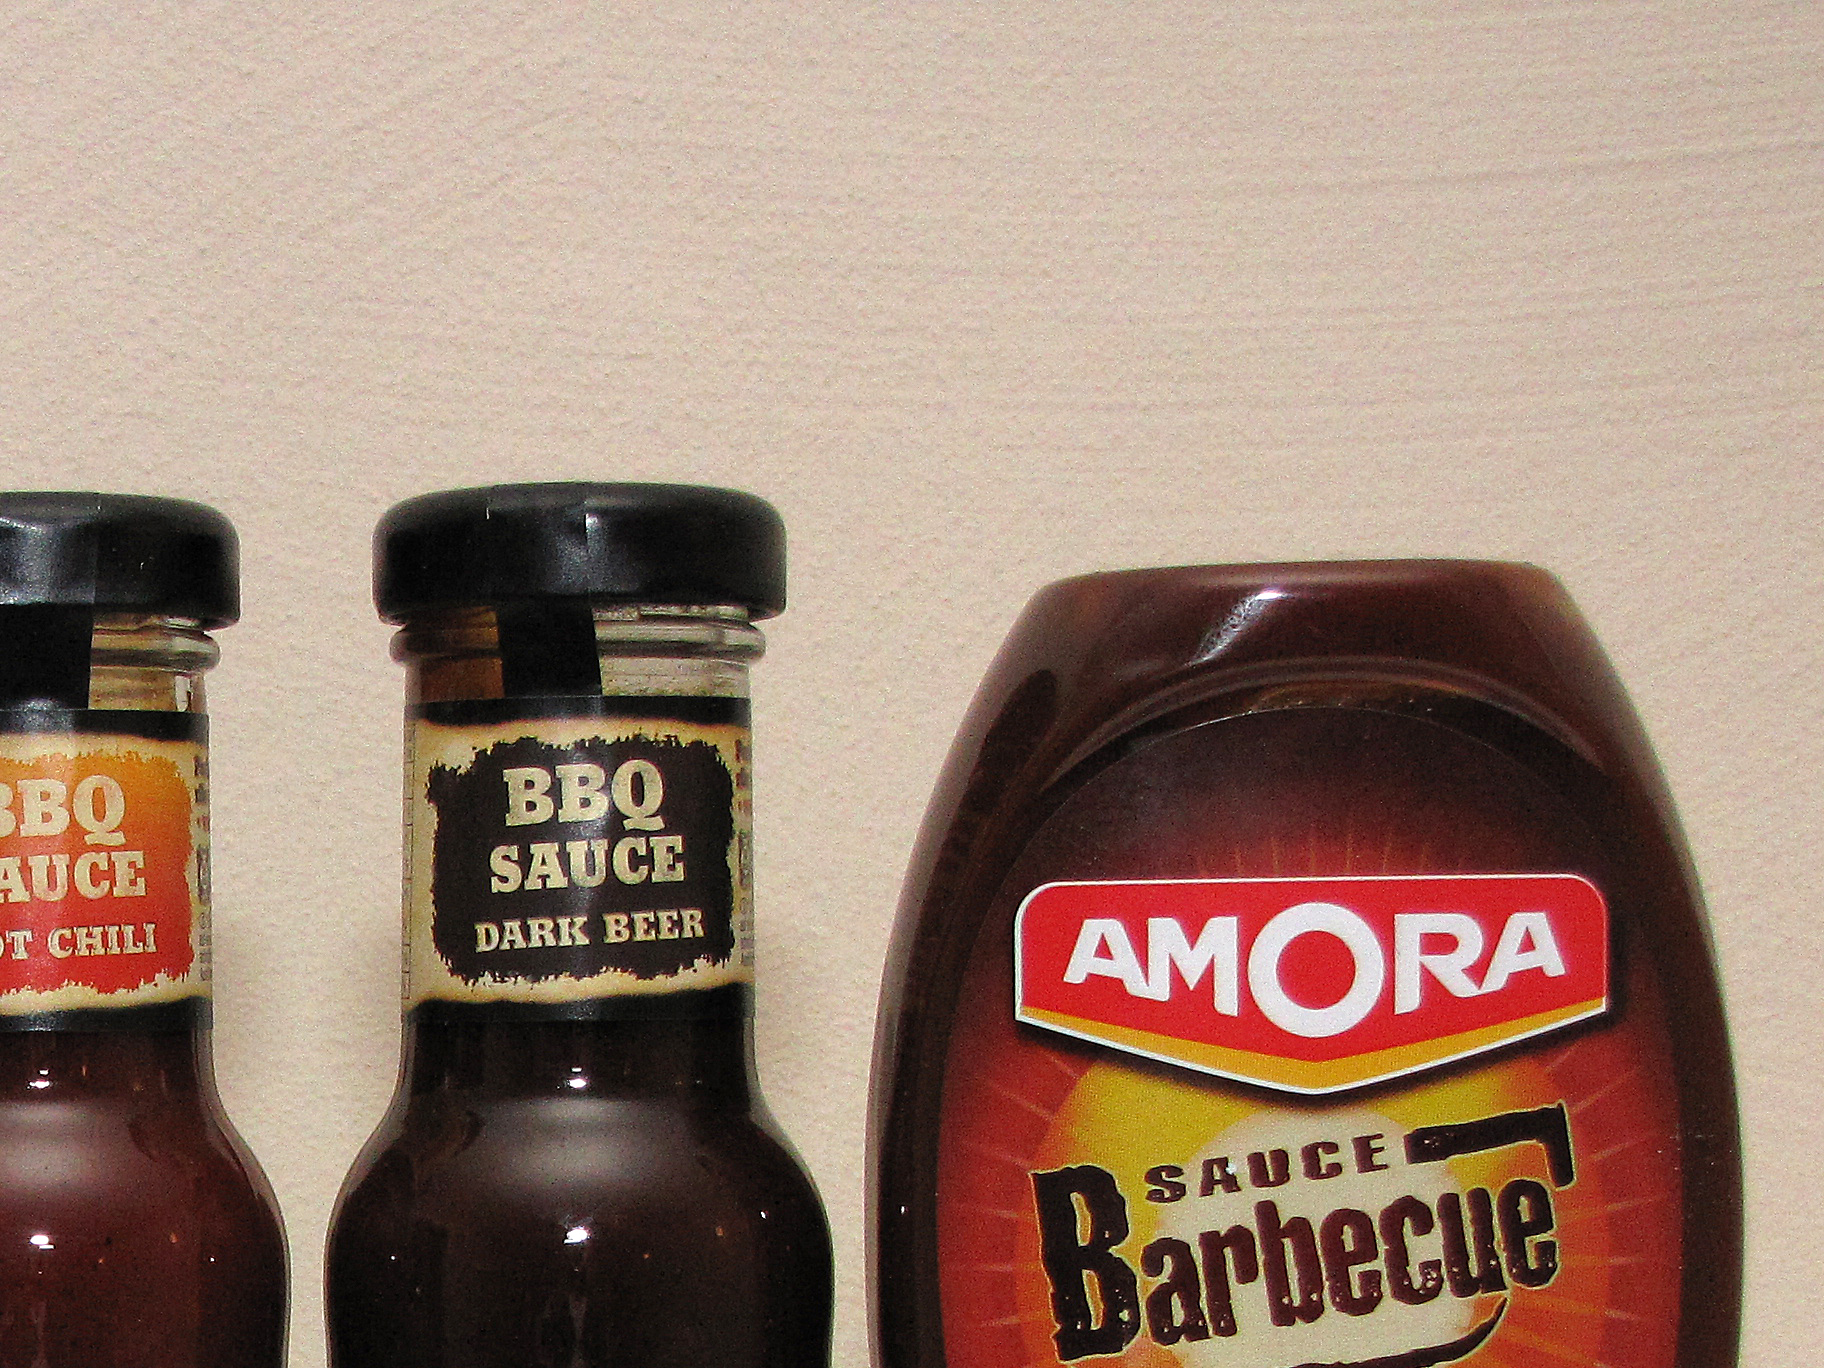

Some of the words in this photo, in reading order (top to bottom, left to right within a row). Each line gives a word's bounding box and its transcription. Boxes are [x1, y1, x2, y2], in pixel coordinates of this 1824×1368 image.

[502, 759, 665, 831] BBQ
[489, 835, 685, 893] SAUCE
[48, 924, 157, 959] CHILI
[475, 914, 591, 953] DARK
[603, 908, 704, 944] BEER
[1063, 901, 1566, 1038] AMORA
[1145, 1132, 1386, 1204] SAUCE
[1030, 1163, 1562, 1362] Barbecue
